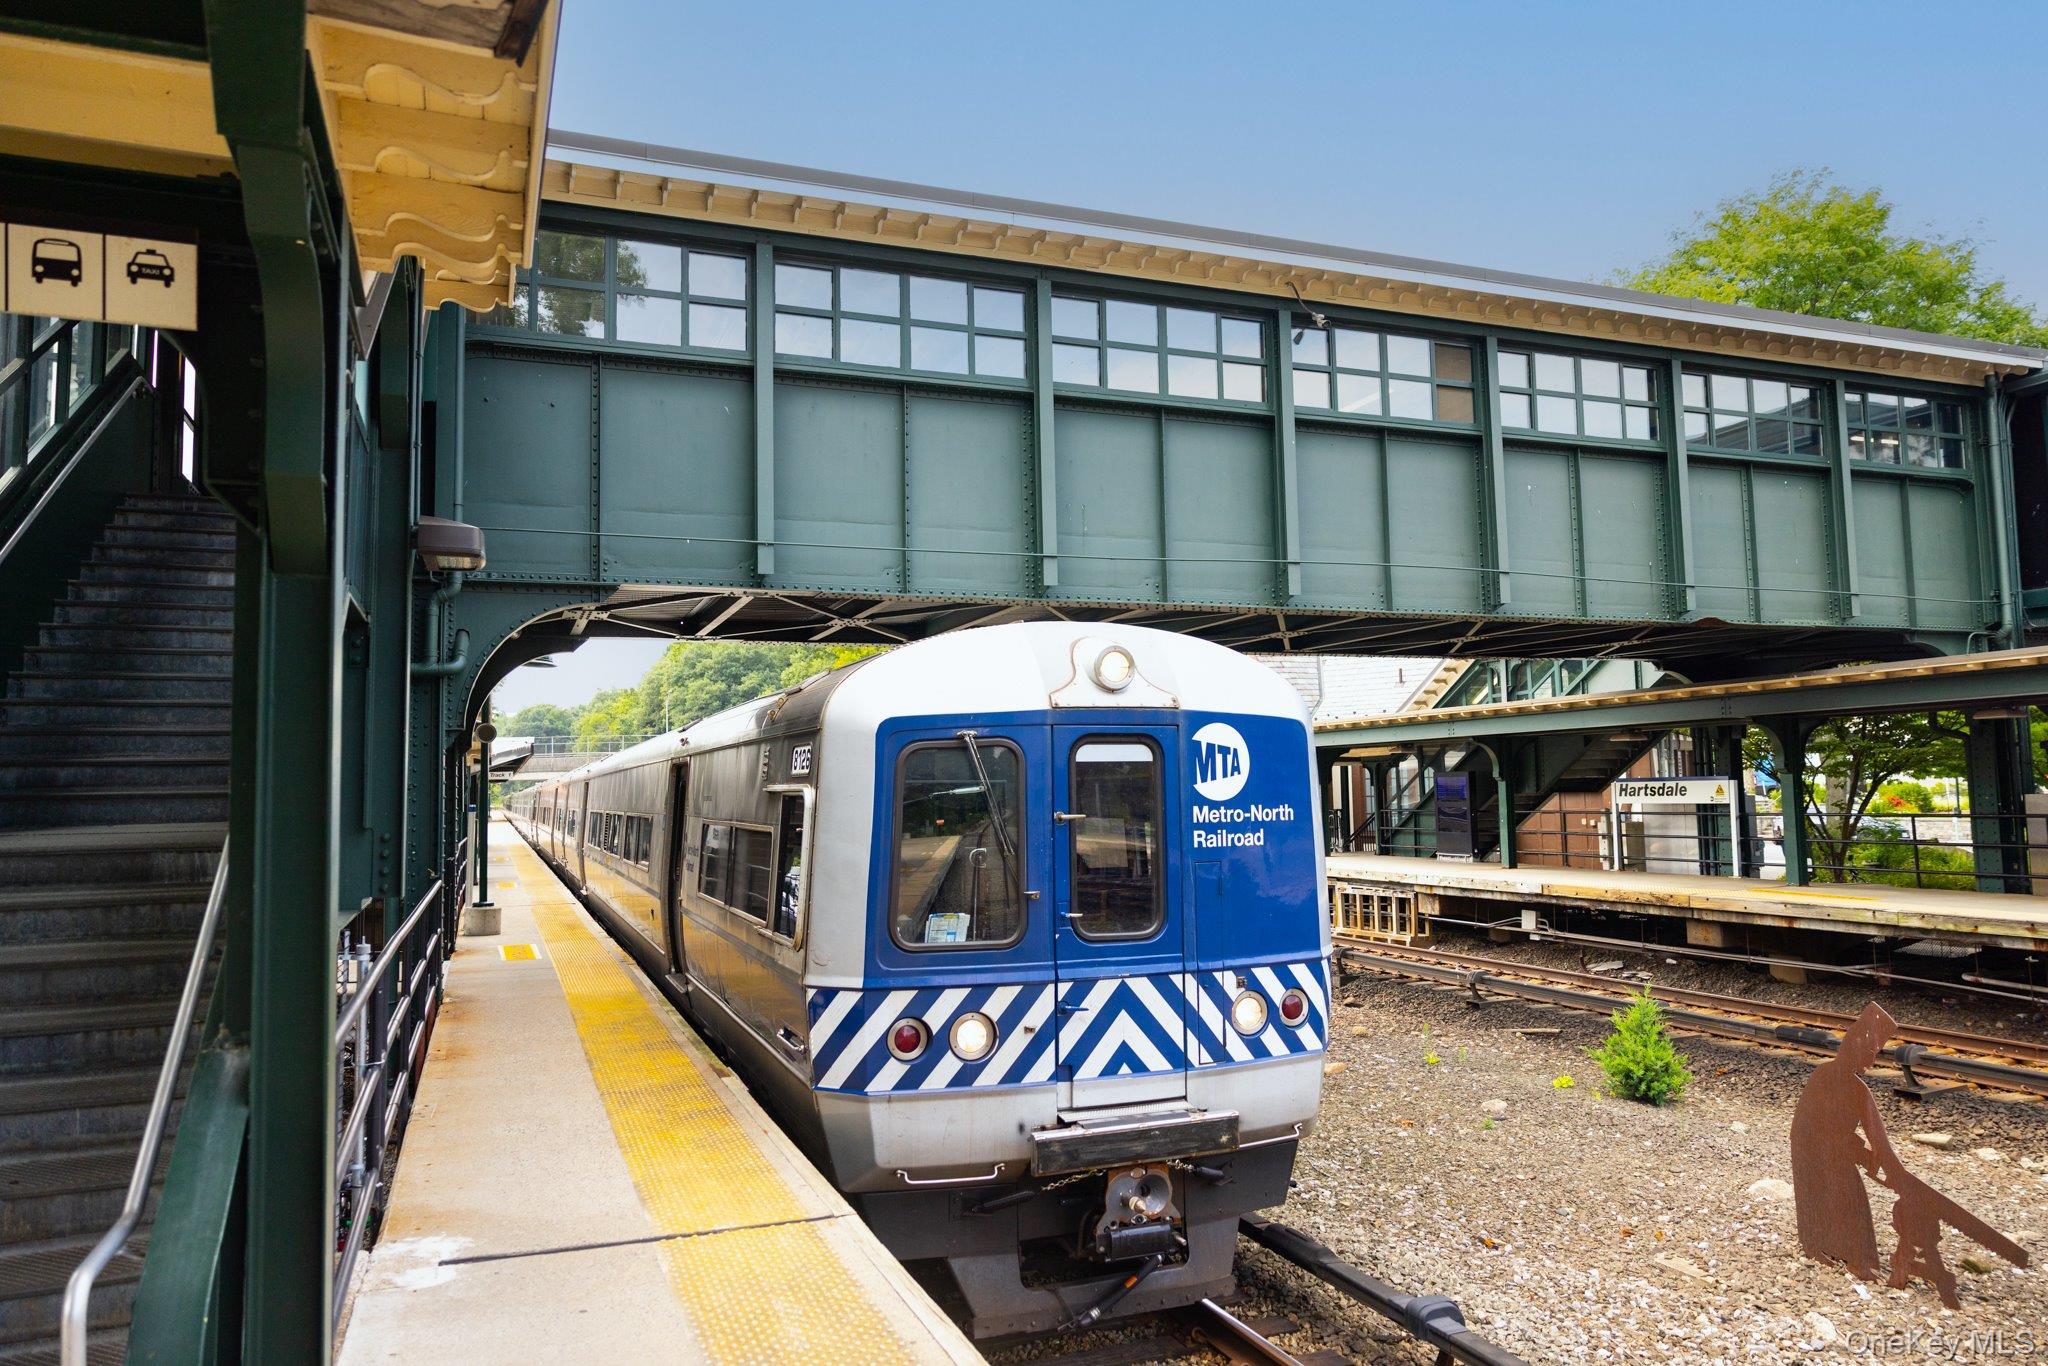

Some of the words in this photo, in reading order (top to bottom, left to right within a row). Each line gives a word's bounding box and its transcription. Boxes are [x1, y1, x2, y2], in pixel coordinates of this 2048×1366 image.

[1194, 739, 1241, 784] MTA
[1619, 782, 1688, 797] Hartsdale
[1192, 804, 1294, 823] Metro-North
[1193, 829, 1265, 848] Railroad
